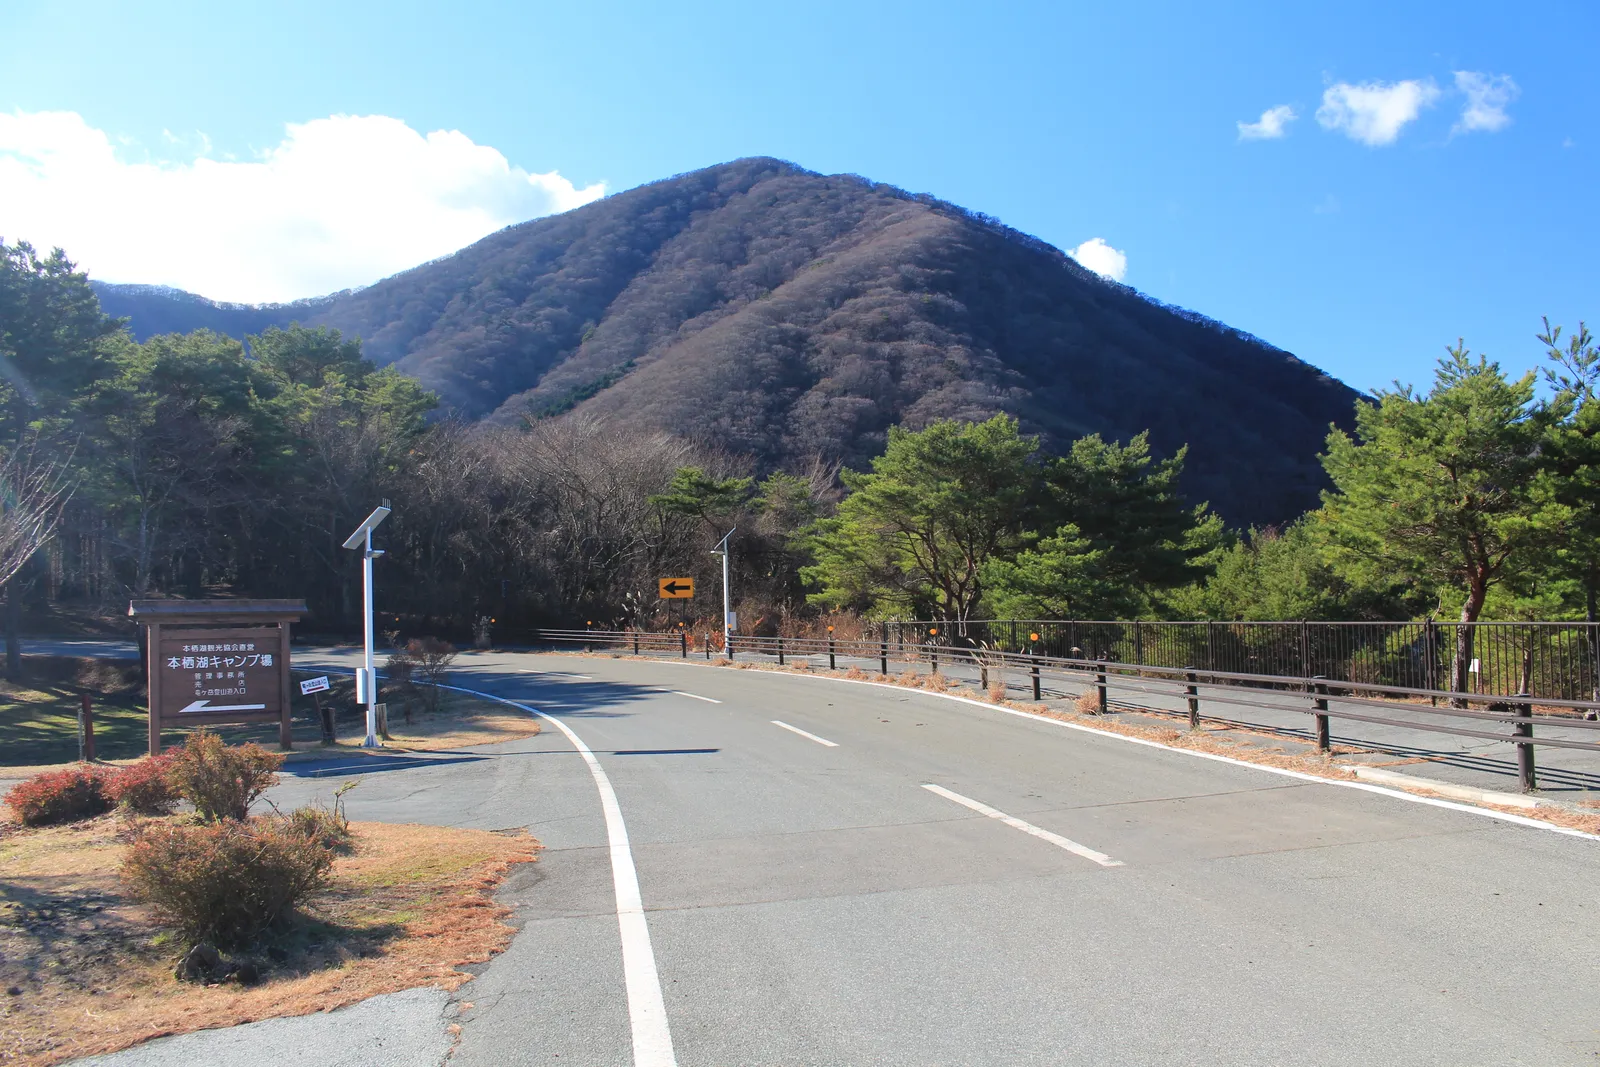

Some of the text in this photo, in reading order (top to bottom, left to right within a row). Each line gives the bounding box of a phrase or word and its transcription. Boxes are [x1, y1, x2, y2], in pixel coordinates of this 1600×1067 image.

[183, 643, 254, 652] 本栖湖観光協会直営
[167, 654, 273, 670] 本栖湖キャンプ場
